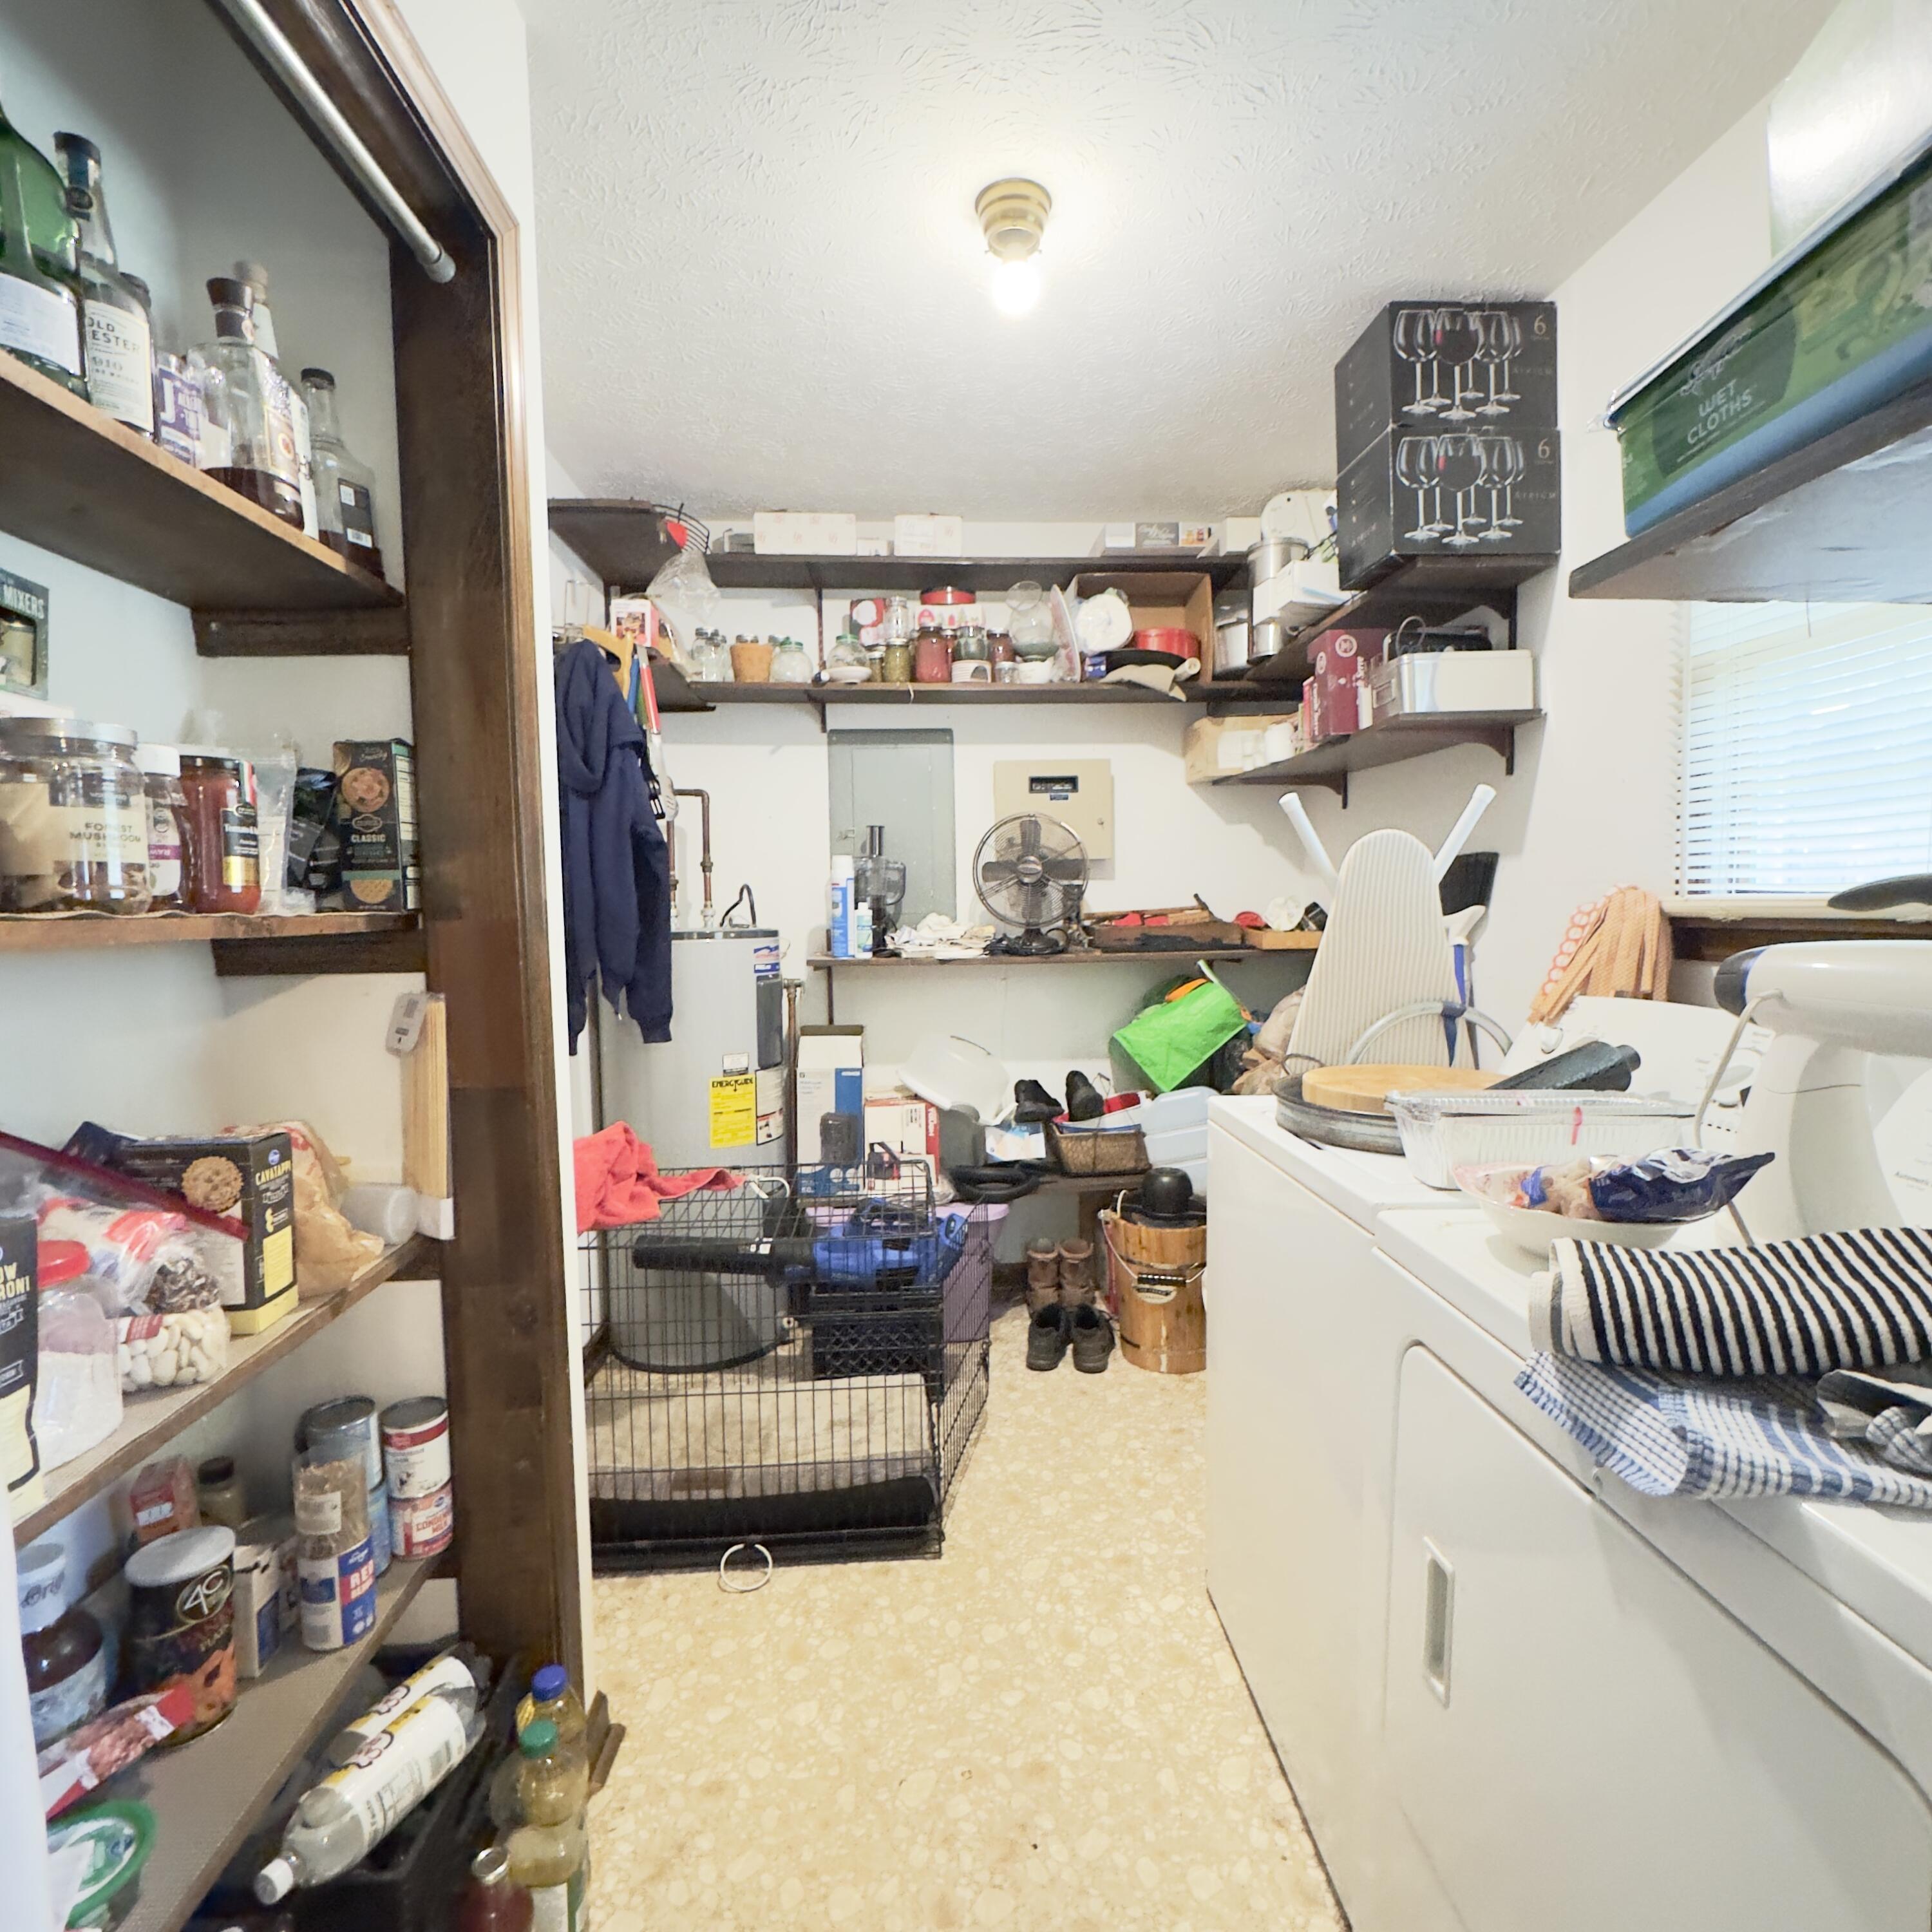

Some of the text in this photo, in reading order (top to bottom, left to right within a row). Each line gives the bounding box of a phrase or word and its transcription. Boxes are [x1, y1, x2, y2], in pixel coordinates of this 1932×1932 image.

[1534, 315, 1546, 335] 6
[1698, 379, 1737, 417] WET
[1687, 388, 1753, 444] CLOTHS
[1537, 438, 1550, 459] 6
[3, 583, 44, 620] MIXERS
[69, 831, 142, 843] MUSOOM
[84, 821, 133, 833] FOST
[351, 833, 386, 844] CLASSIC
[184, 1571, 223, 1615] 4C
